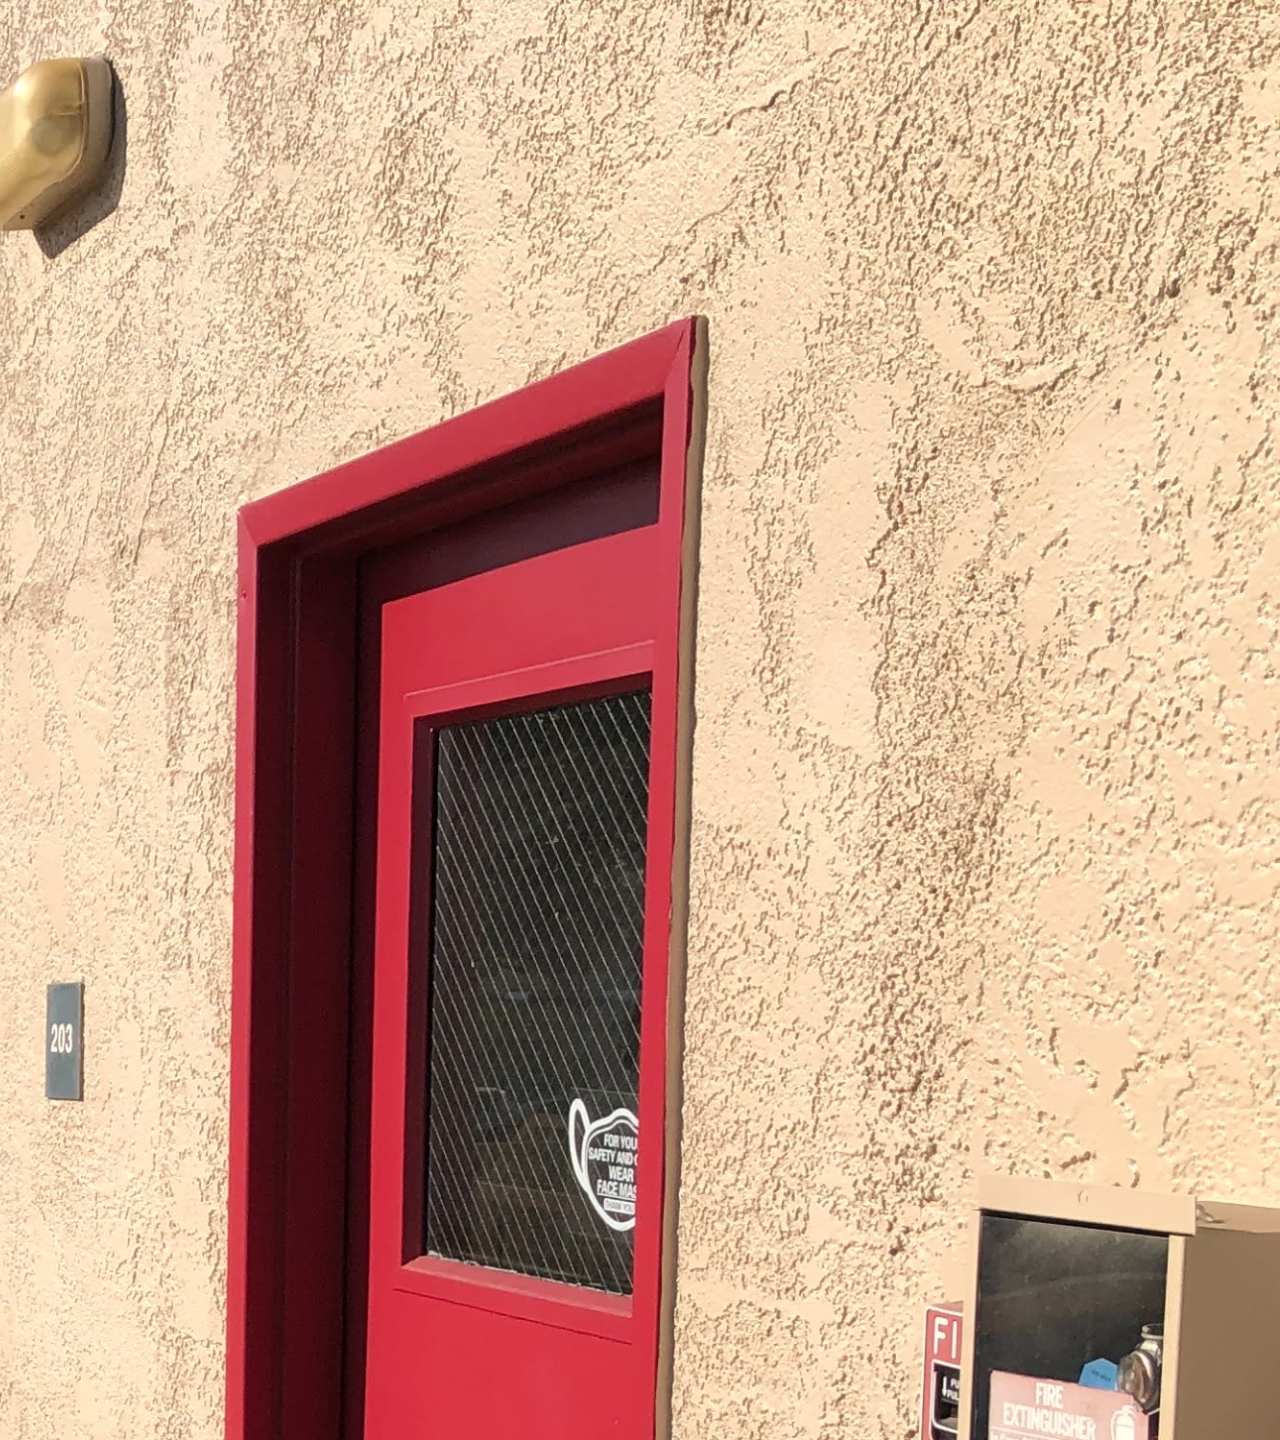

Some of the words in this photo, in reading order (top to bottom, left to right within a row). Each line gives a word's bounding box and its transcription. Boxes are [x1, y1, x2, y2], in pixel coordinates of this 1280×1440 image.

[50, 1023, 73, 1054] 203
[603, 1133, 619, 1148] FOR
[620, 1135, 638, 1151] YOU
[588, 1147, 616, 1162] SAFETY
[616, 1151, 634, 1166] AND
[608, 1165, 634, 1183] WEAR
[596, 1178, 618, 1196] FACE
[619, 1182, 638, 1199] MAS
[933, 1316, 958, 1360] FI
[1035, 1382, 1064, 1409] FIRE
